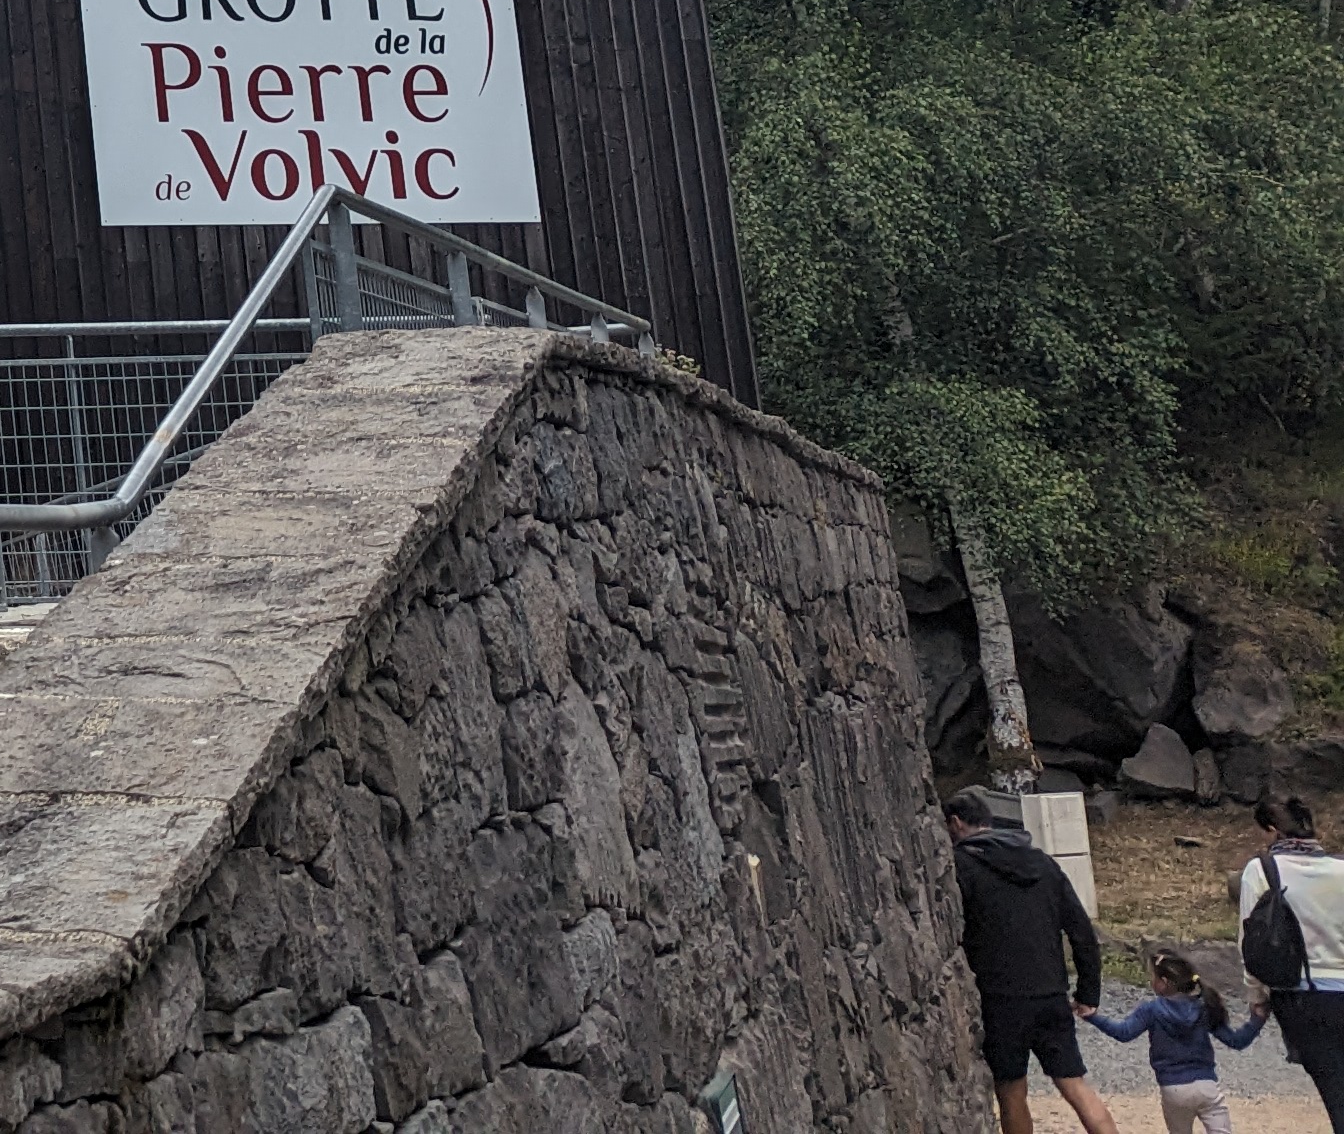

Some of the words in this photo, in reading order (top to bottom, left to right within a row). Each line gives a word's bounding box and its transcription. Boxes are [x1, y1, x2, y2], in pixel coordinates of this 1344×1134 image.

[374, 28, 410, 55] de
[418, 28, 446, 55] la
[140, 42, 449, 123] Pierre
[155, 174, 192, 201] de
[181, 129, 460, 202] Volvic
